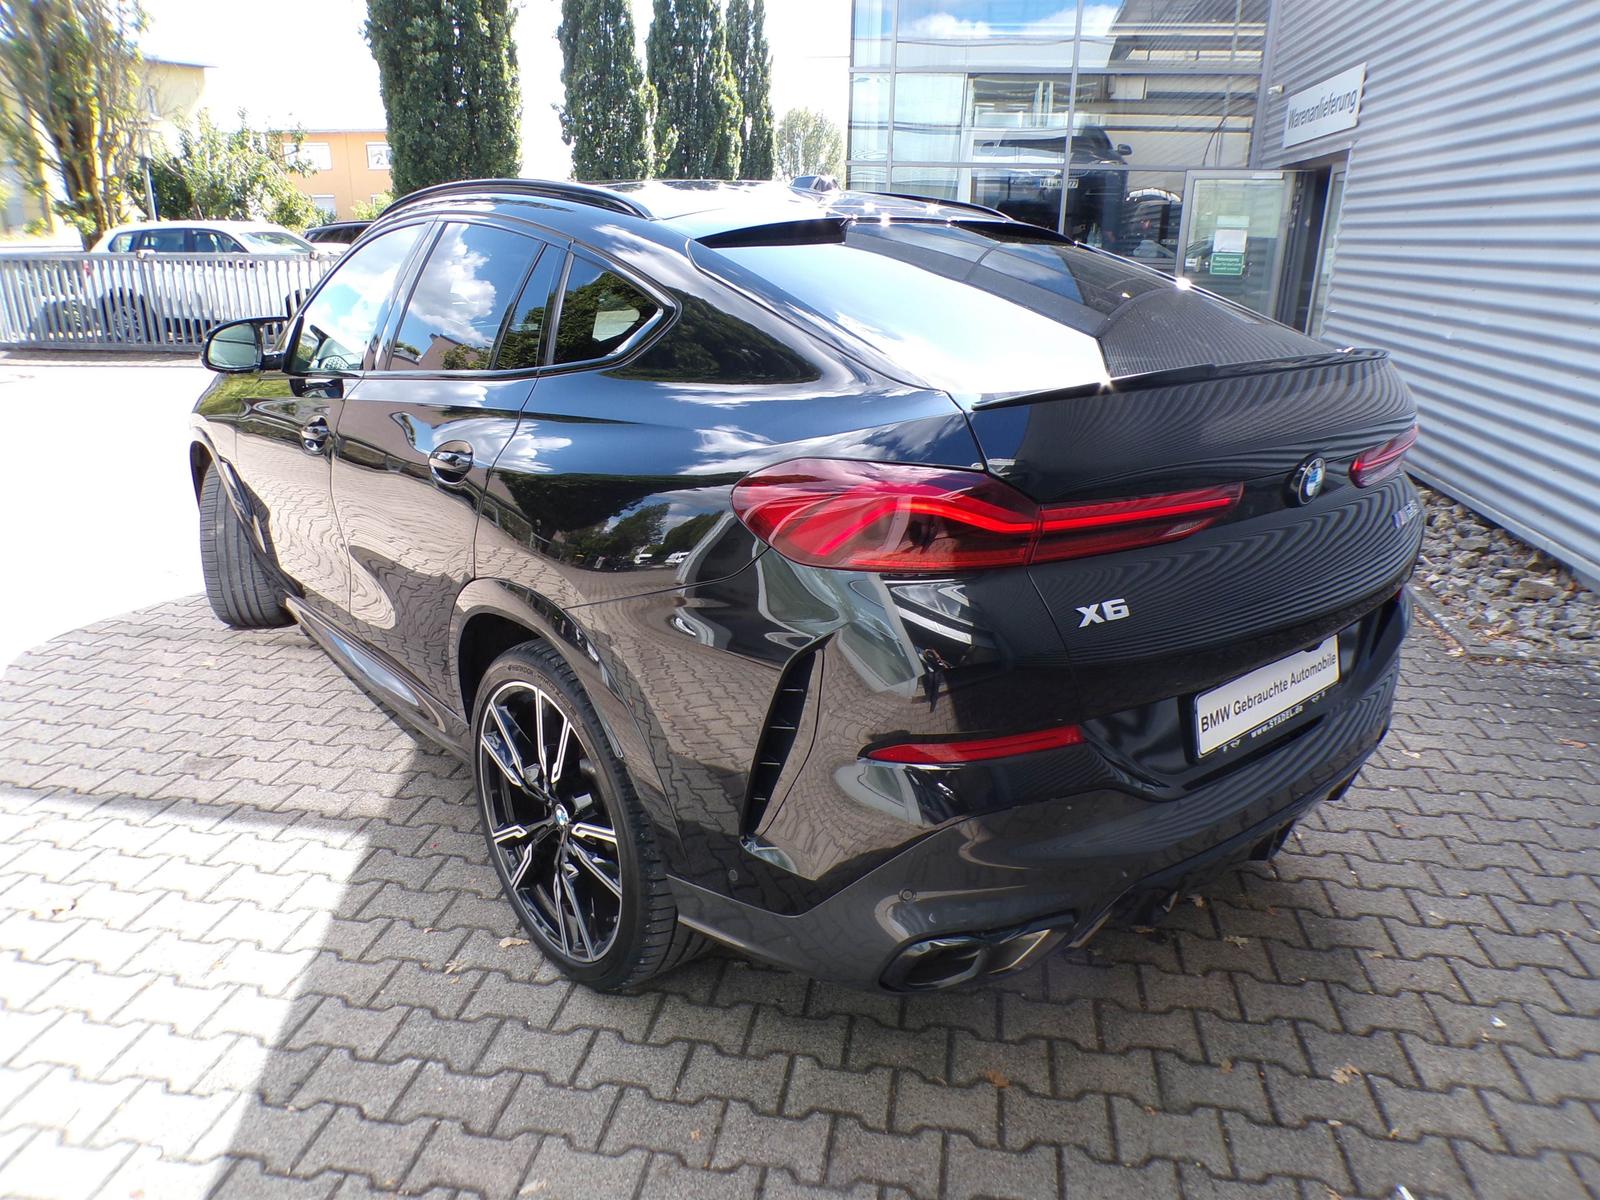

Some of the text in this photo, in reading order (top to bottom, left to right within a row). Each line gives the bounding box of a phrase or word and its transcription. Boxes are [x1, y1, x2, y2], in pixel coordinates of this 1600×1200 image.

[1288, 89, 1358, 129] Warenanlieferung
[1075, 598, 1130, 628] X6
[1200, 653, 1336, 733] BMW Gebrauchte Automobile
